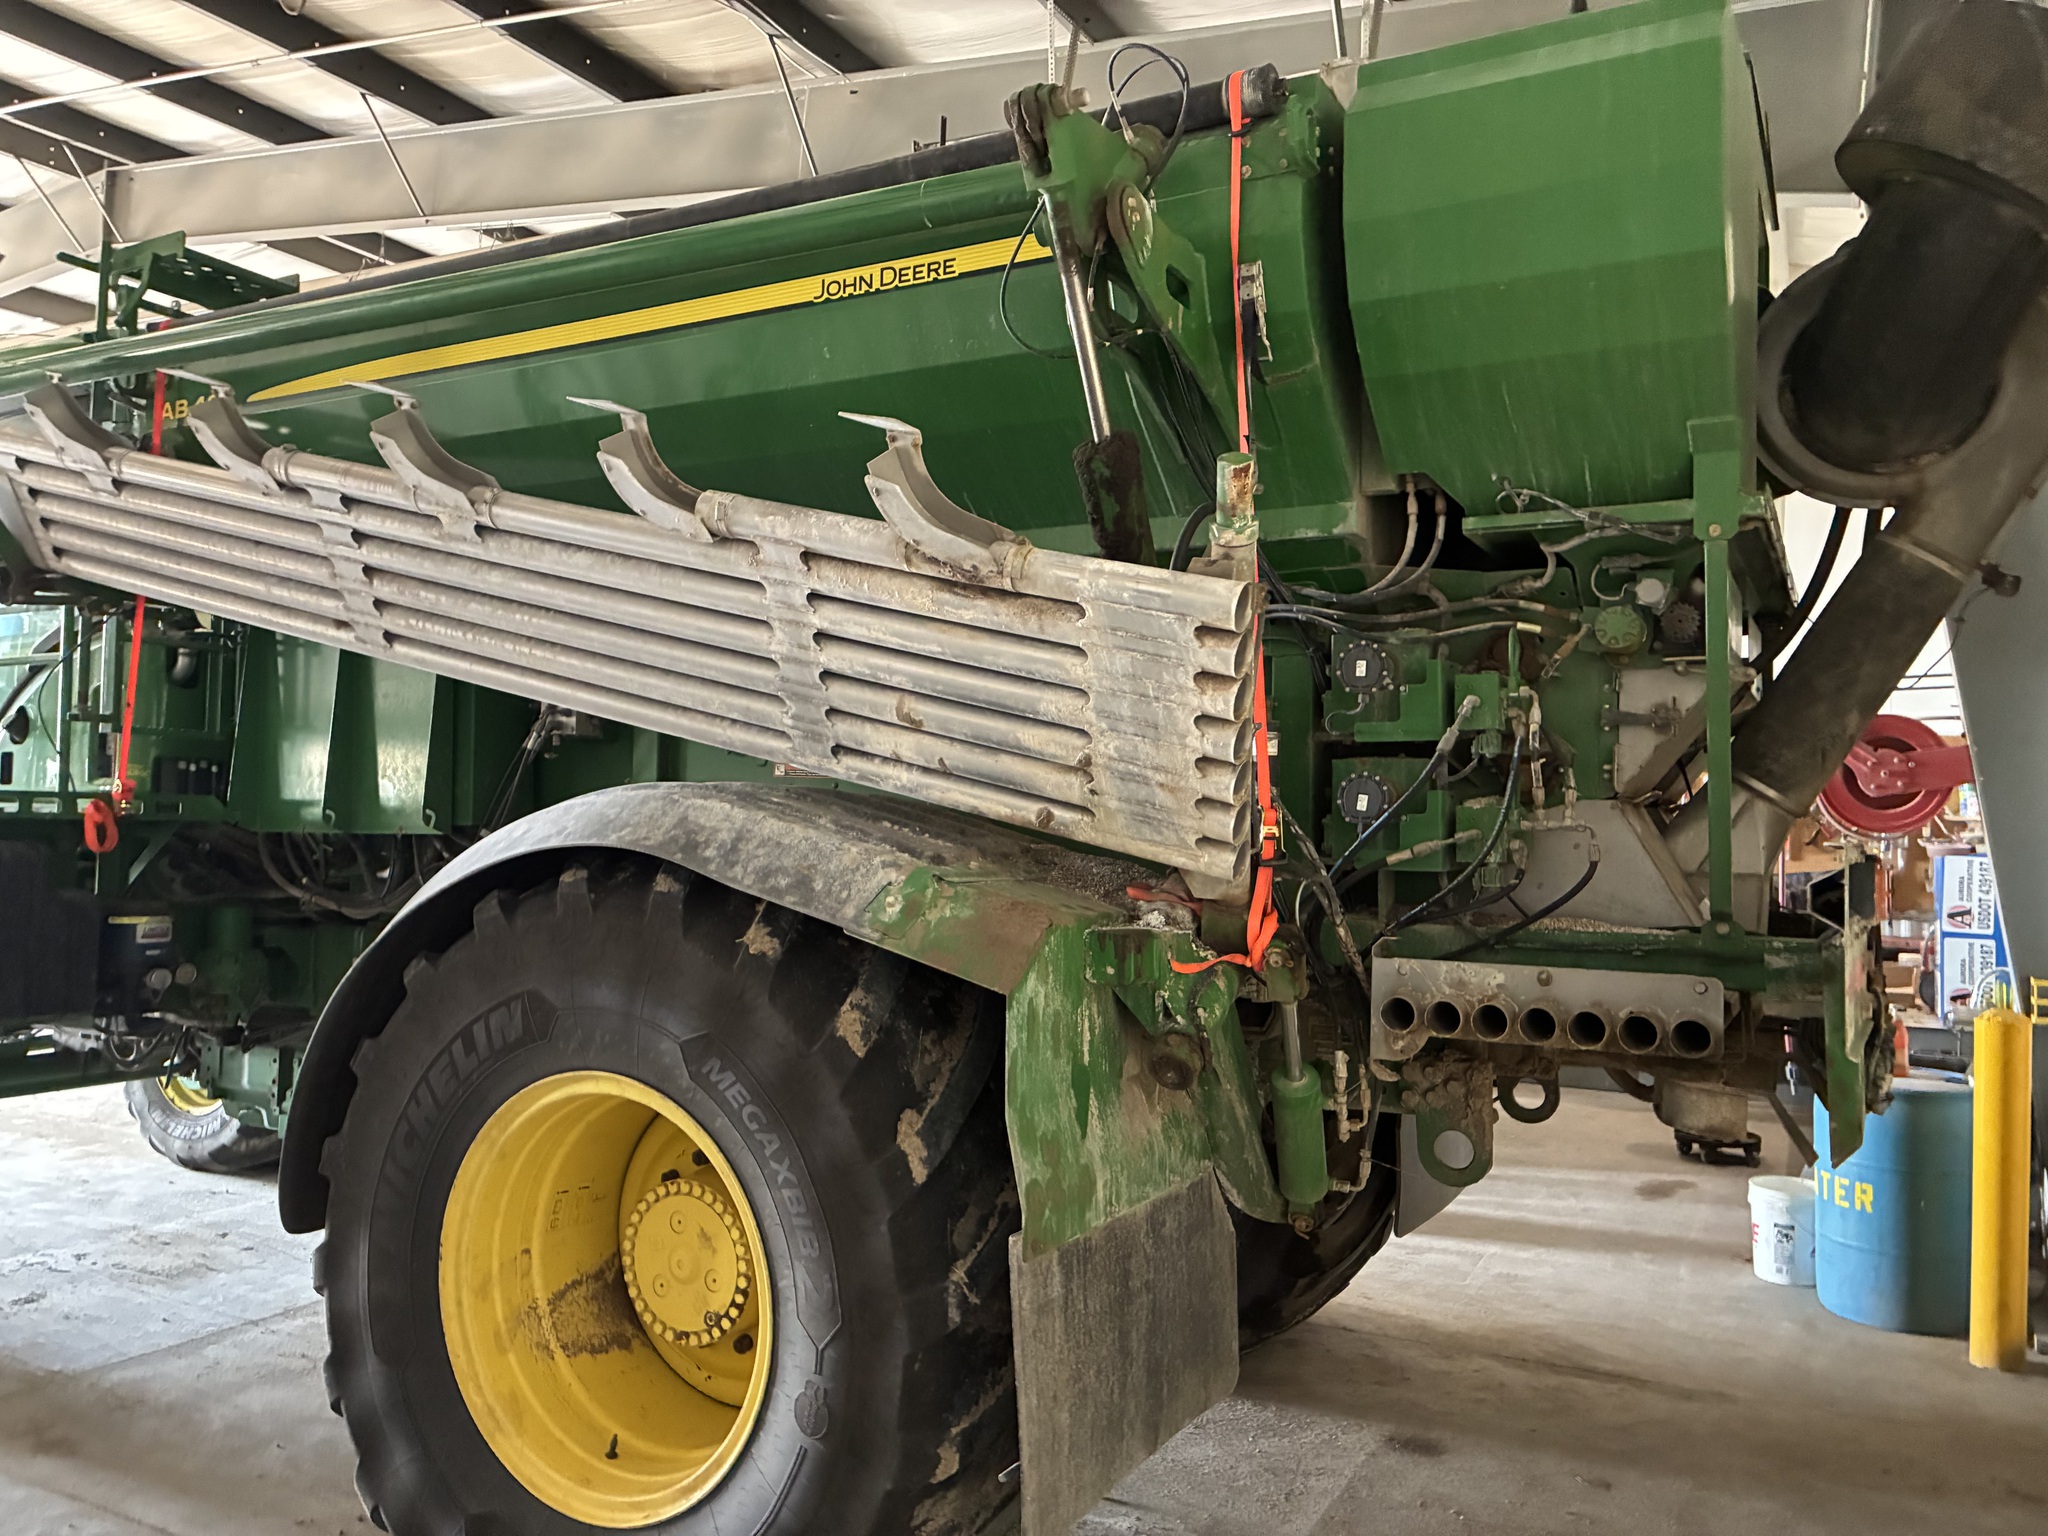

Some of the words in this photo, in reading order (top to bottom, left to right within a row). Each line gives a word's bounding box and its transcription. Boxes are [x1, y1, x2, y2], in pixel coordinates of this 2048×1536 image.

[813, 273, 874, 300] JOHN
[880, 257, 957, 288] DEERE
[1977, 897, 1993, 931] USDOT
[702, 1056, 820, 1258] MEGAXBIB
